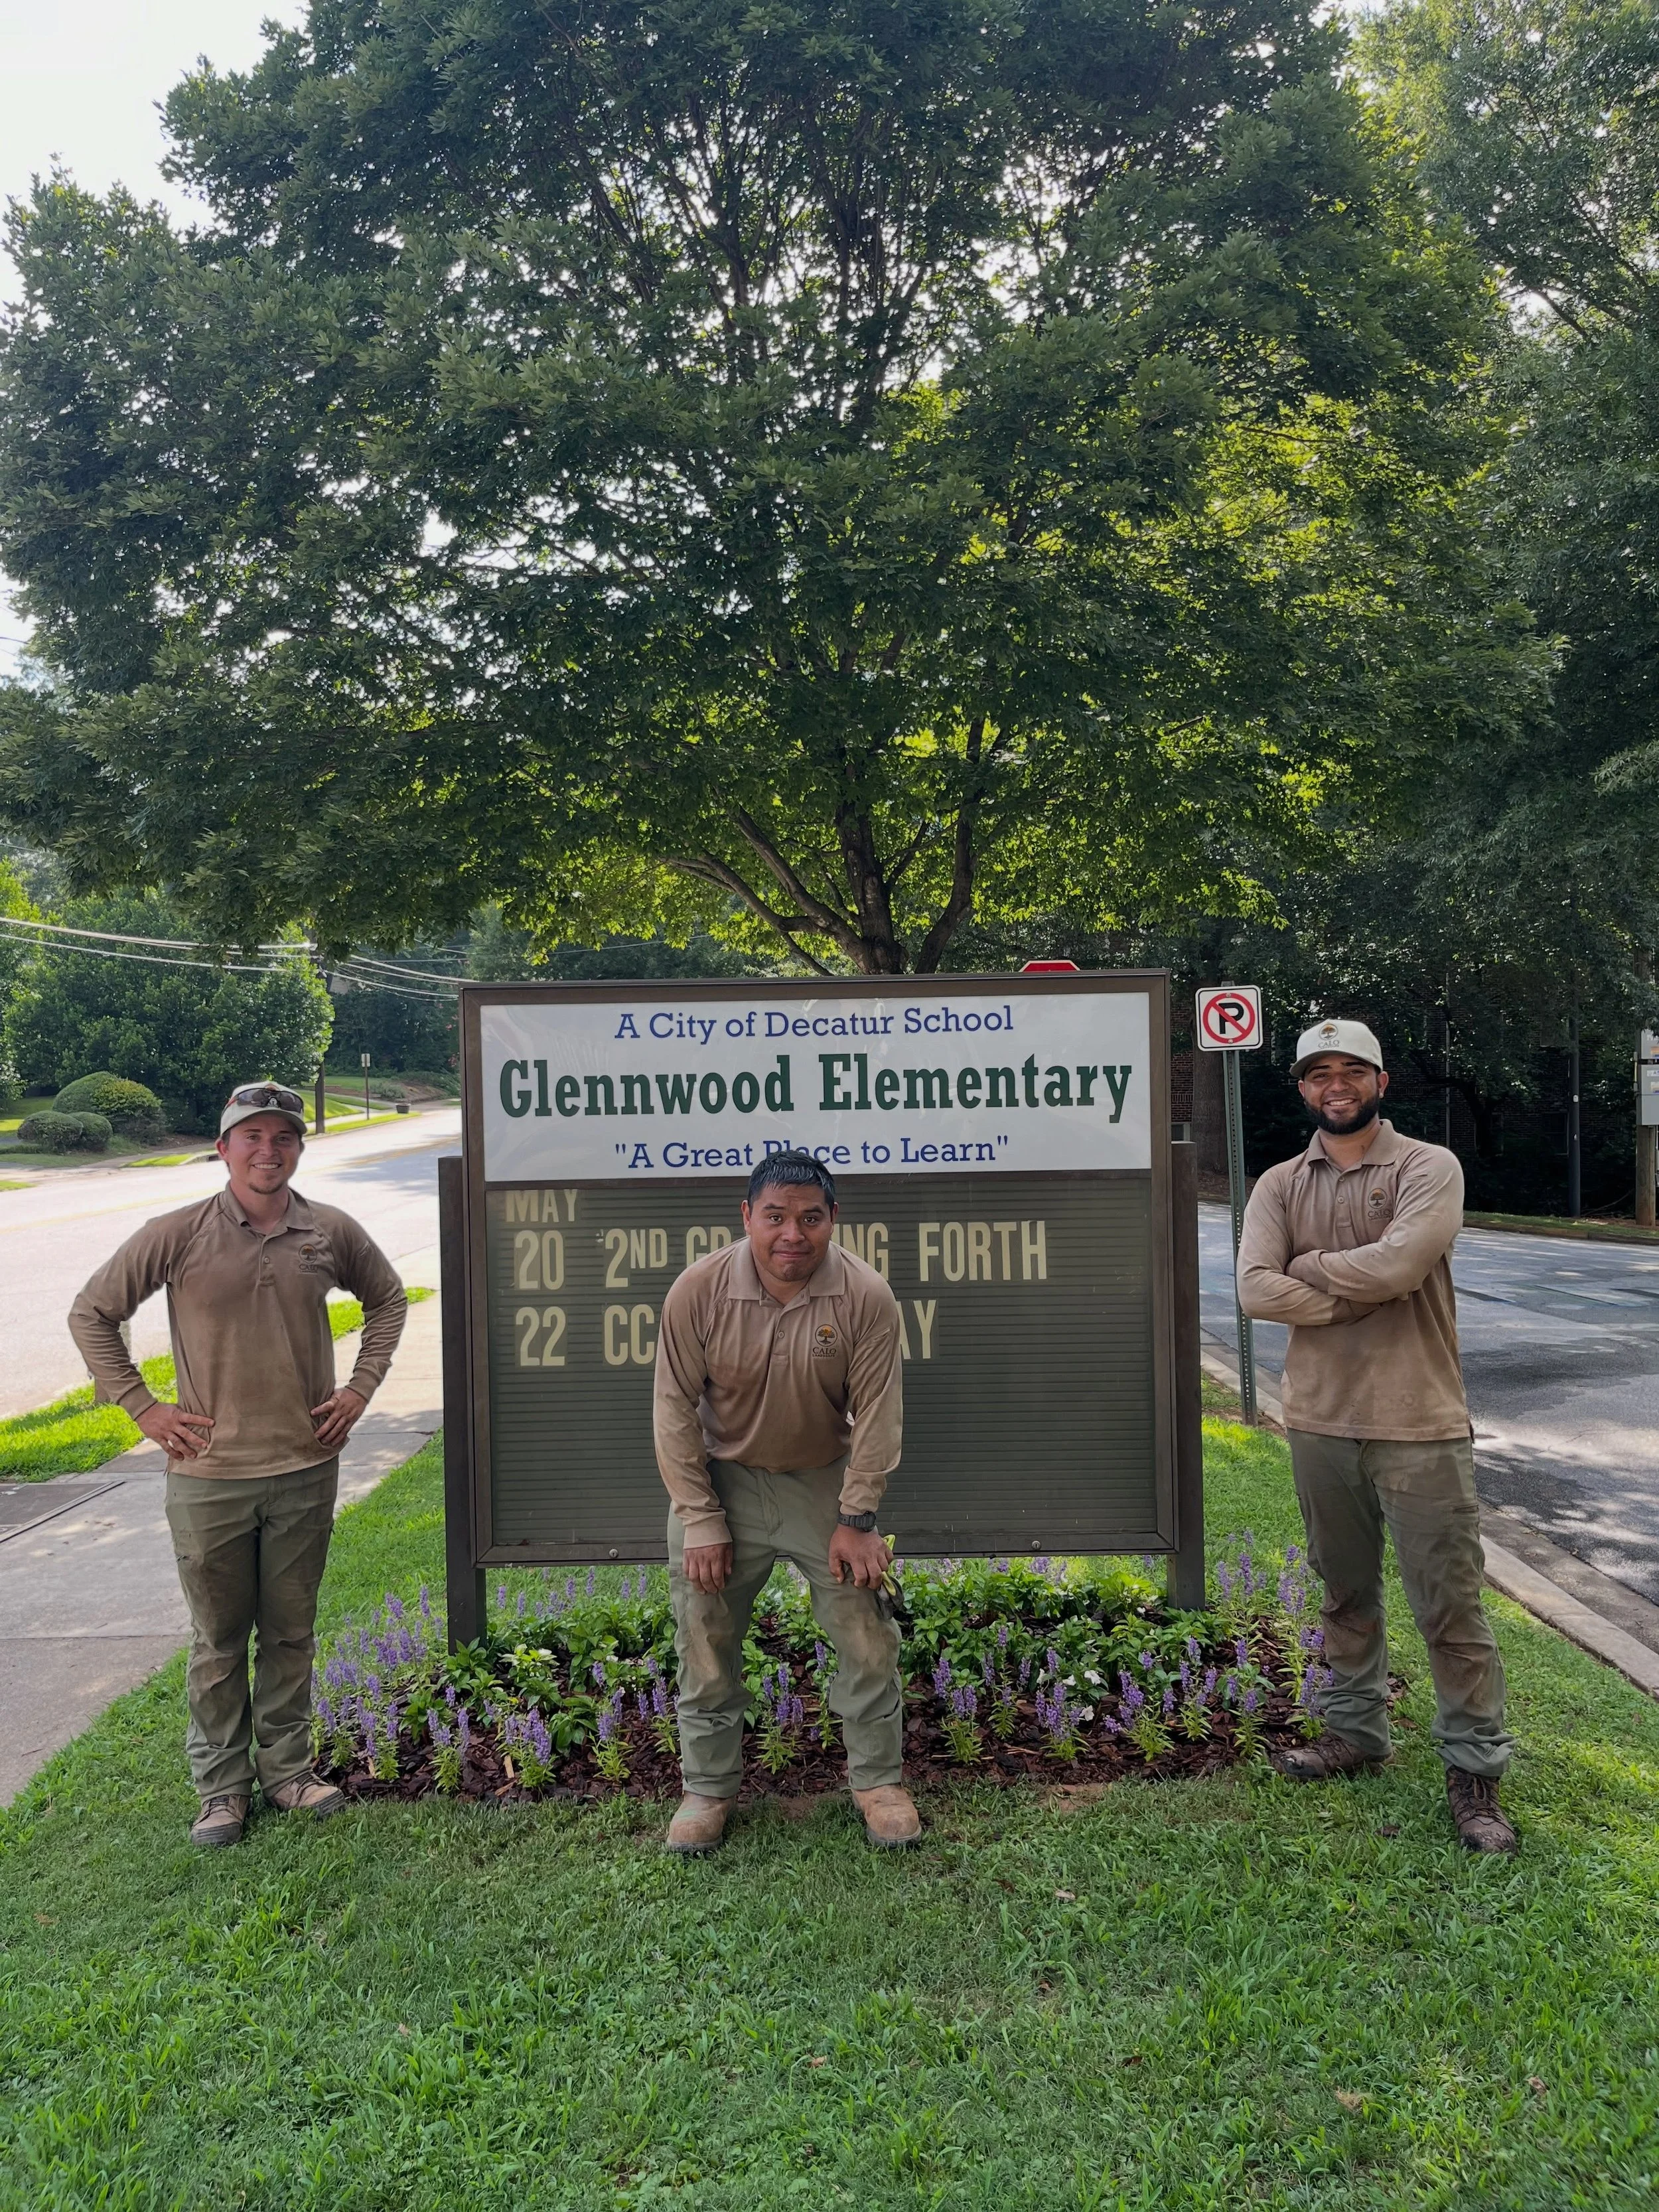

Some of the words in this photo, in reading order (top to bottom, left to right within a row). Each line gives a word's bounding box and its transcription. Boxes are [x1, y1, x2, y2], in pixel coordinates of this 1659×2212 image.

[615, 1014, 640, 1038] A
[650, 1013, 717, 1045] City
[726, 1011, 757, 1037] of
[764, 1012, 894, 1037] Decatur
[904, 1005, 1013, 1033] School
[500, 1054, 794, 1118] Glennwood
[819, 1053, 1131, 1123] Elementary
[616, 1143, 654, 1168] "A
[663, 1142, 753, 1167] Great
[861, 1141, 891, 1163] to
[901, 1136, 1008, 1163] Learn"
[506, 1189, 577, 1222] MAY
[515, 1230, 564, 1290] 20
[605, 1228, 668, 1288] 2ND
[919, 1220, 1047, 1281] FORTH
[516, 1307, 565, 1366] 22
